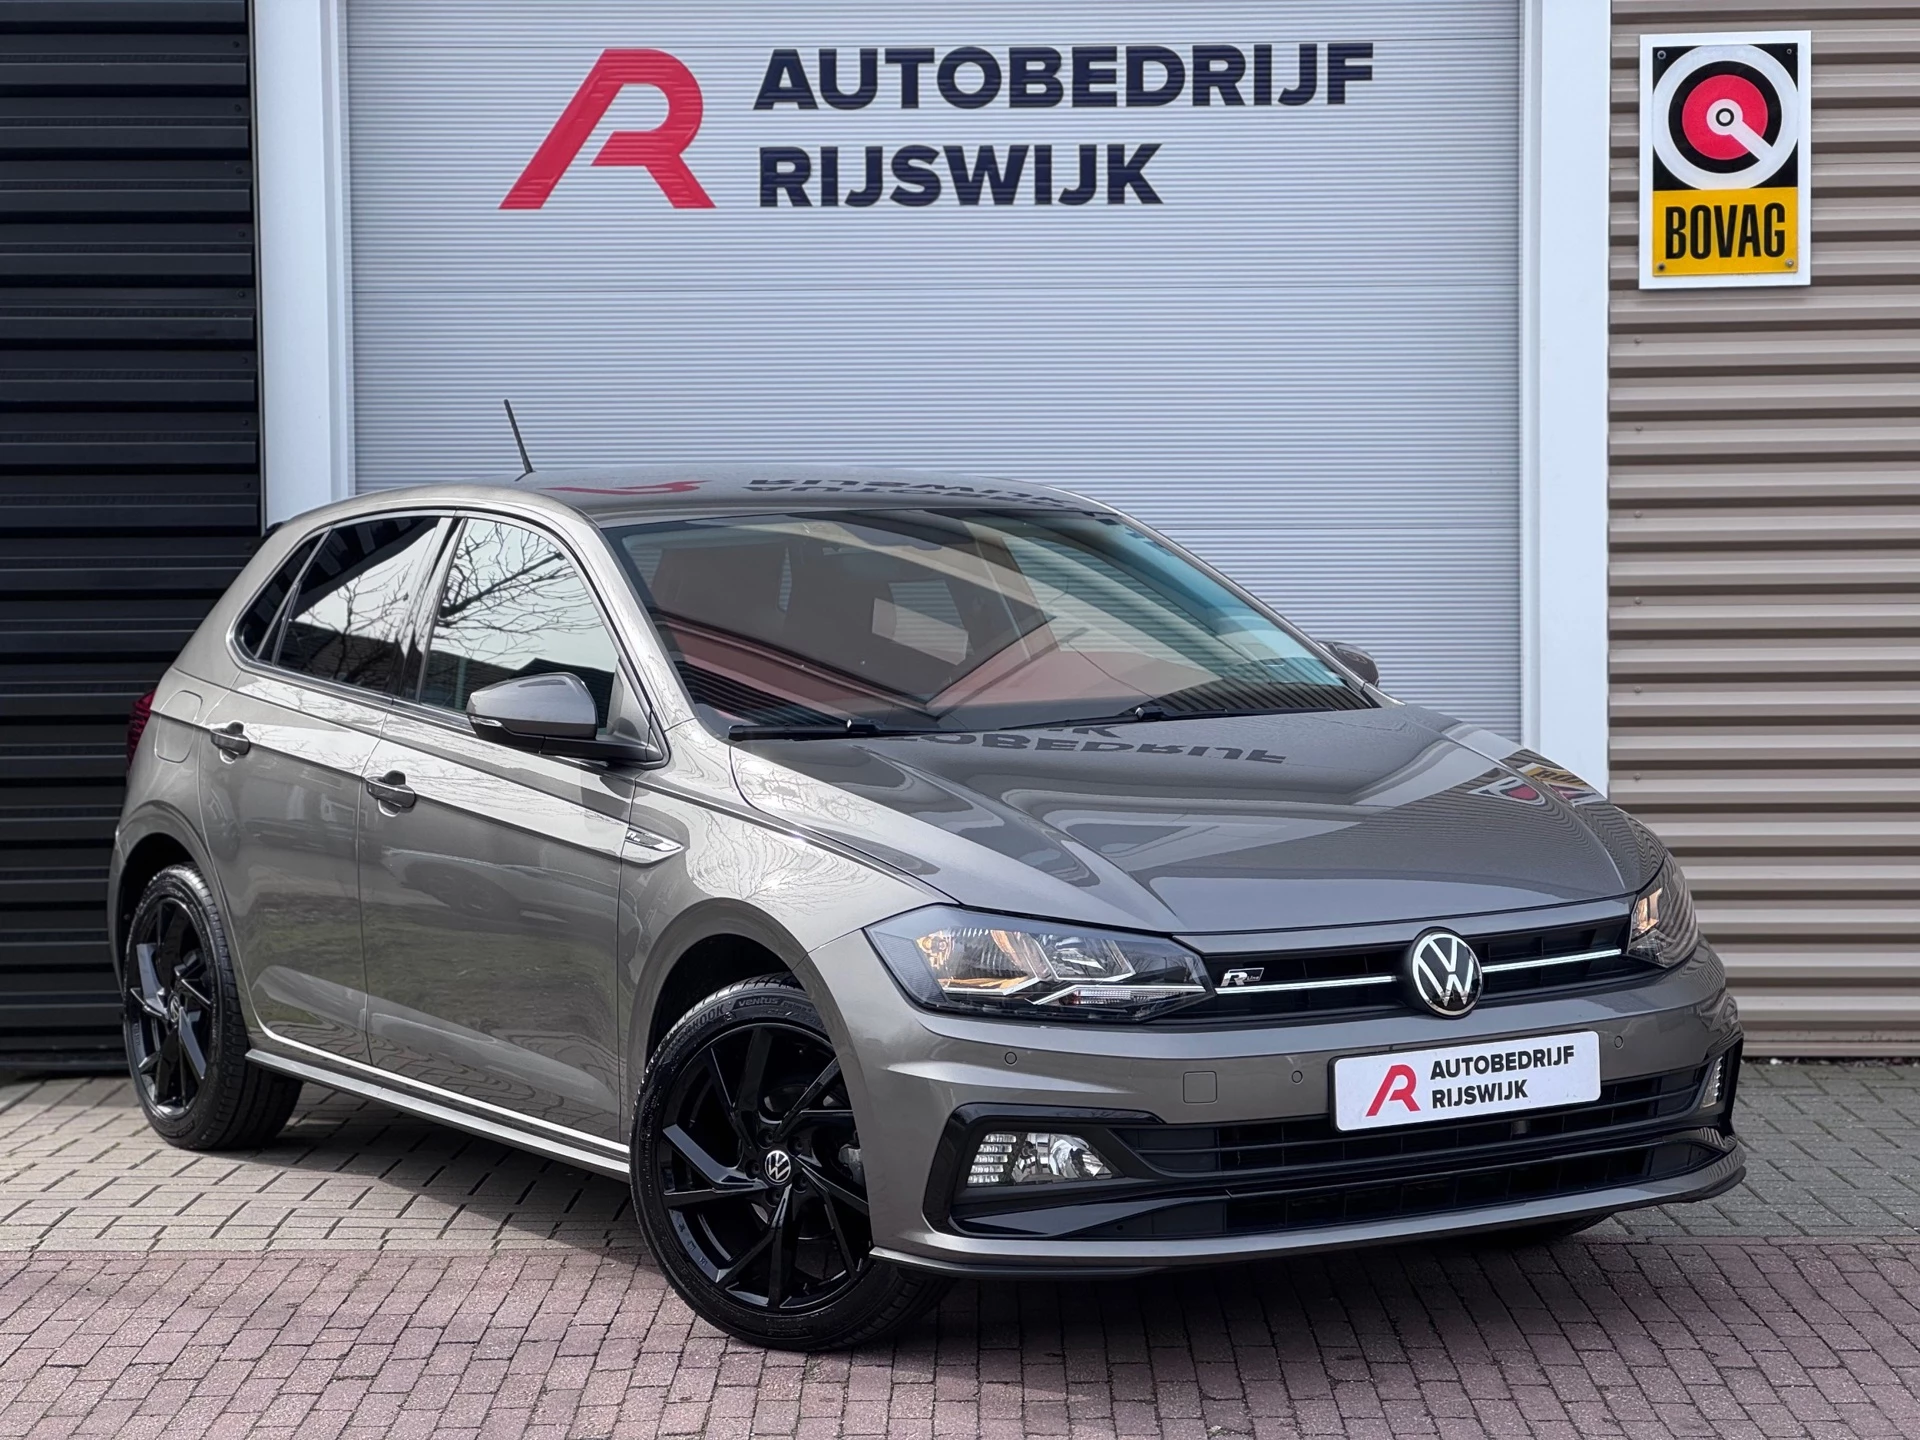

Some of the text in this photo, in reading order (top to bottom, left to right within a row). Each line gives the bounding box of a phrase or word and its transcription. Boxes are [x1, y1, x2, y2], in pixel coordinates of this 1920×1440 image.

[754, 43, 1374, 110] AUTOBEDRIJF
[760, 143, 1163, 208] RIJSWIJK
[1665, 202, 1786, 261] BOVAG
[1430, 1045, 1575, 1081] AUTOBEDRIJF
[1431, 1079, 1529, 1110] RIJSWIJK
